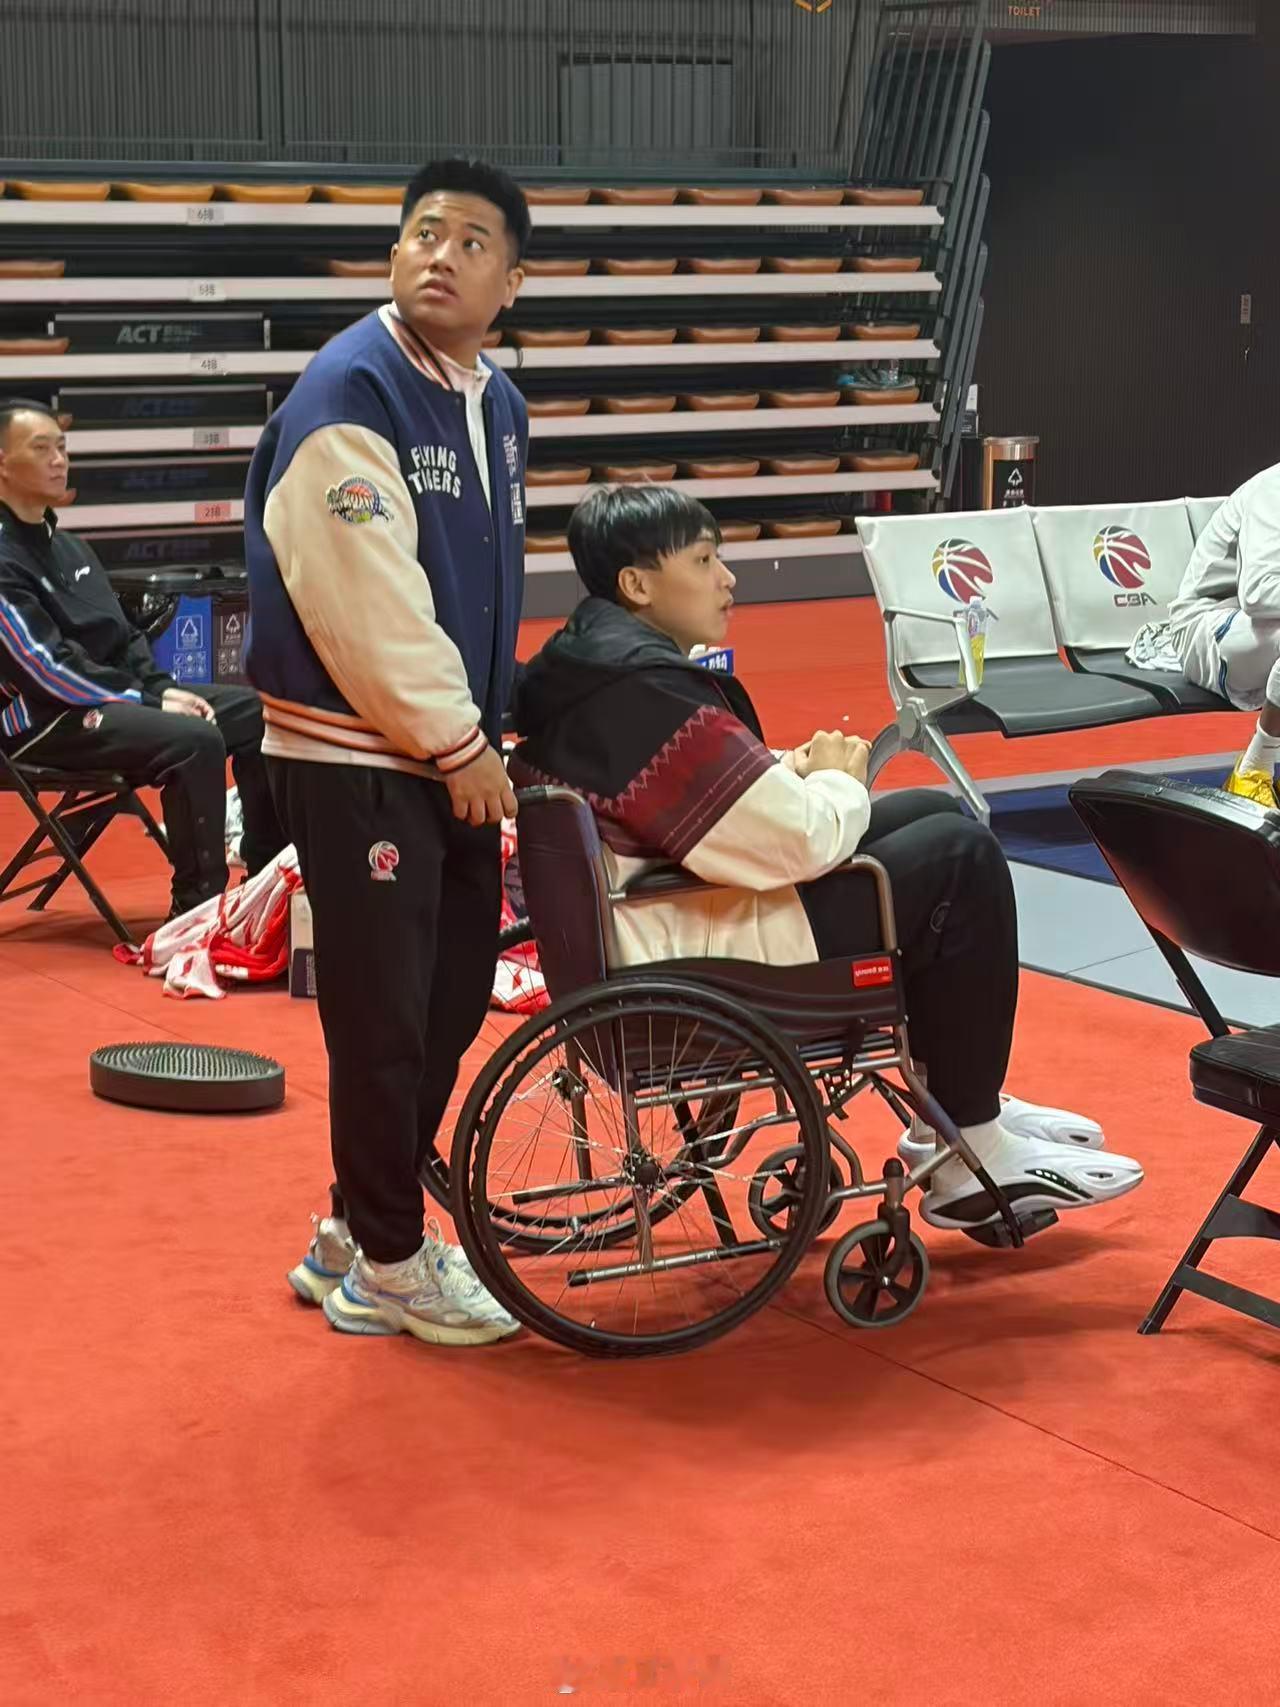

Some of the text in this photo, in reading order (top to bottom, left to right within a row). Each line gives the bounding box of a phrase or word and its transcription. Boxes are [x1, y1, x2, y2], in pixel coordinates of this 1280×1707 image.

[1008, 6, 1041, 16] TOILET
[116, 325, 163, 344] ACT
[410, 444, 457, 473] FLYING
[1114, 592, 1158, 607] CBA
